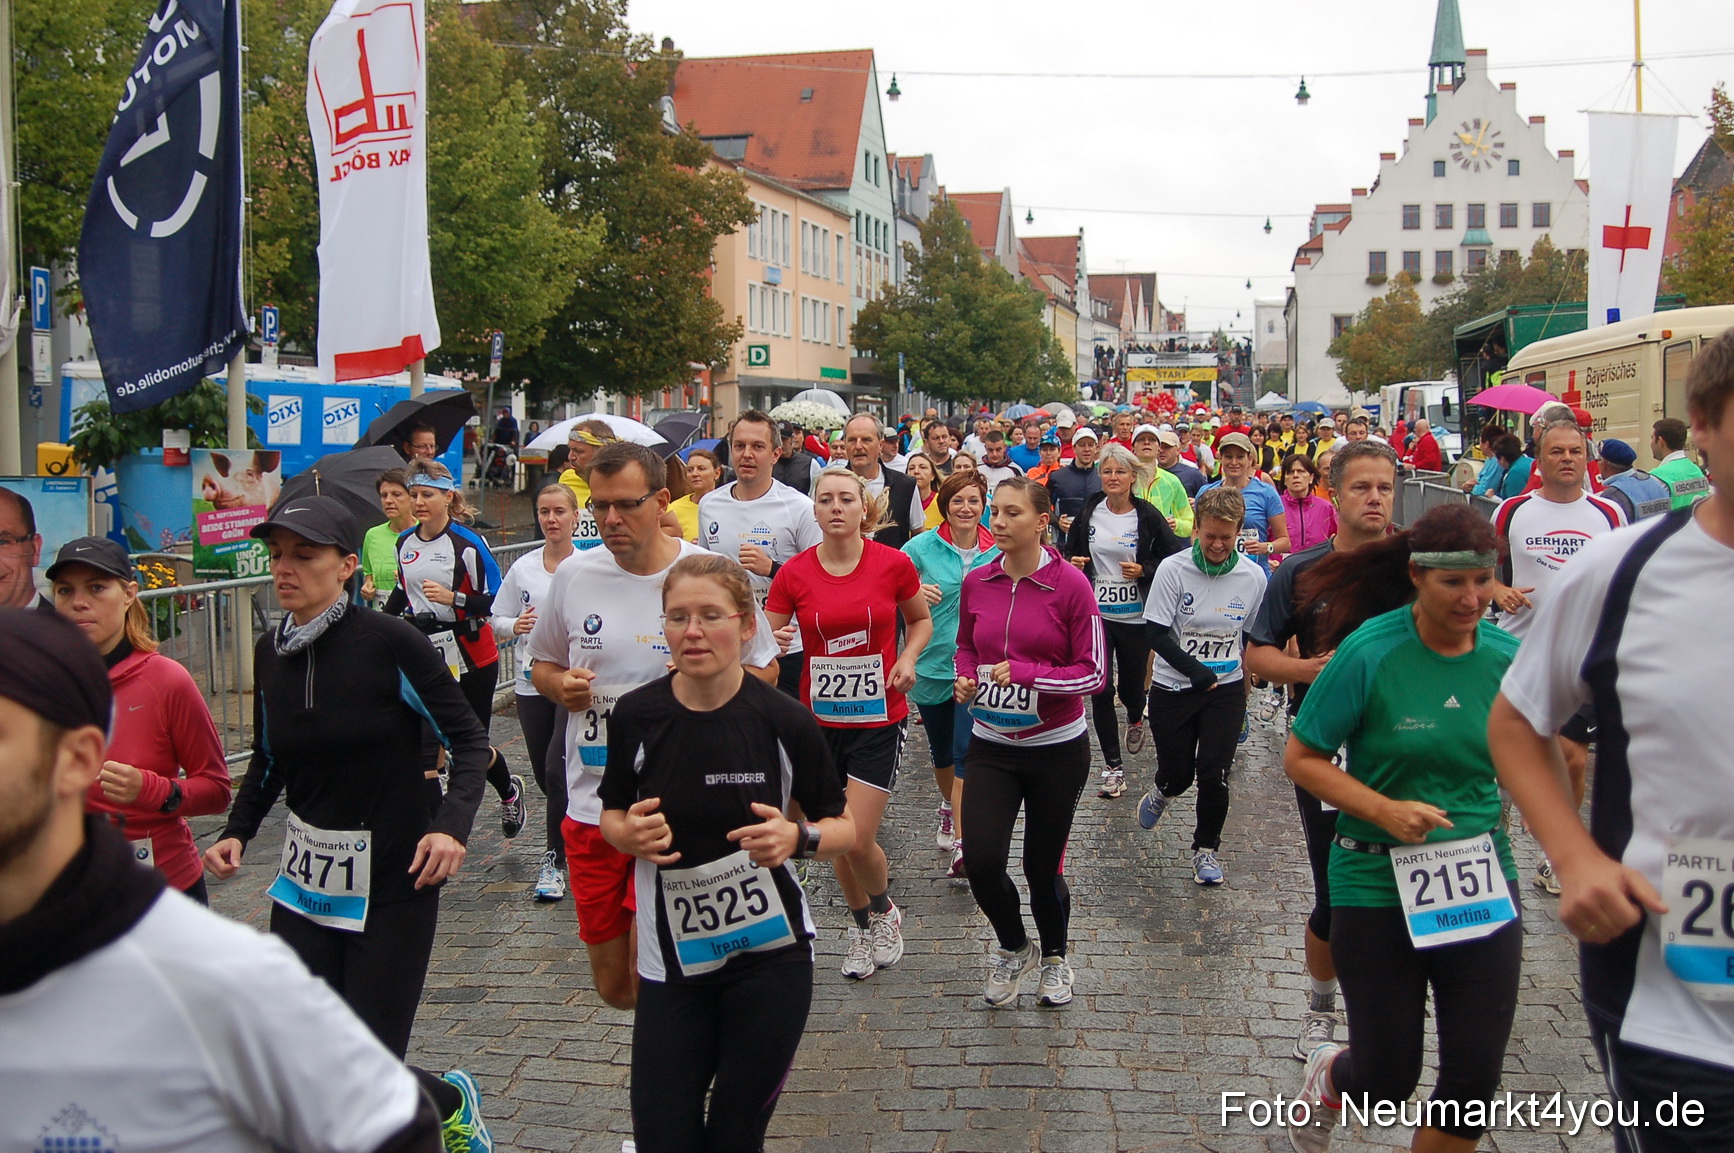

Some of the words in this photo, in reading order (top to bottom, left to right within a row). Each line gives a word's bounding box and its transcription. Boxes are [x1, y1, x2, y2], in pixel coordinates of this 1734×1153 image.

[750, 347, 767, 364] D
[1156, 371, 1188, 379] START
[1585, 359, 1637, 388] Bayerisches
[1585, 390, 1610, 410] Rotes
[201, 522, 224, 533] BEIDE
[225, 517, 266, 529] STIMMEN
[222, 528, 245, 539] GRÜN
[1525, 536, 1586, 547] GERHART
[1098, 585, 1138, 603] 2509
[1106, 605, 1130, 613] Kerstin
[580, 636, 603, 645] PARTL
[838, 637, 856, 648] DEHN
[1186, 639, 1235, 659] 2477
[811, 663, 835, 671] PARTL
[836, 662, 871, 671] Neumarkt
[817, 671, 878, 698] 2275
[974, 682, 1031, 711] 2029
[832, 704, 865, 714] Annika
[715, 772, 766, 784] PFLEIDERER
[287, 821, 303, 841] PARTL
[303, 835, 350, 851] Neumarkt
[286, 840, 355, 891] 2471
[1395, 852, 1433, 867] PARTL
[1434, 844, 1481, 859] Neumarkt
[1667, 853, 1727, 872] PARTL
[663, 878, 691, 892] PARTL
[692, 864, 746, 889] Neumarkt
[1409, 858, 1494, 907] 2157
[297, 892, 331, 913] Katrin
[673, 875, 770, 934] 2525
[1435, 908, 1491, 929] Martina
[711, 935, 750, 957] Irene
